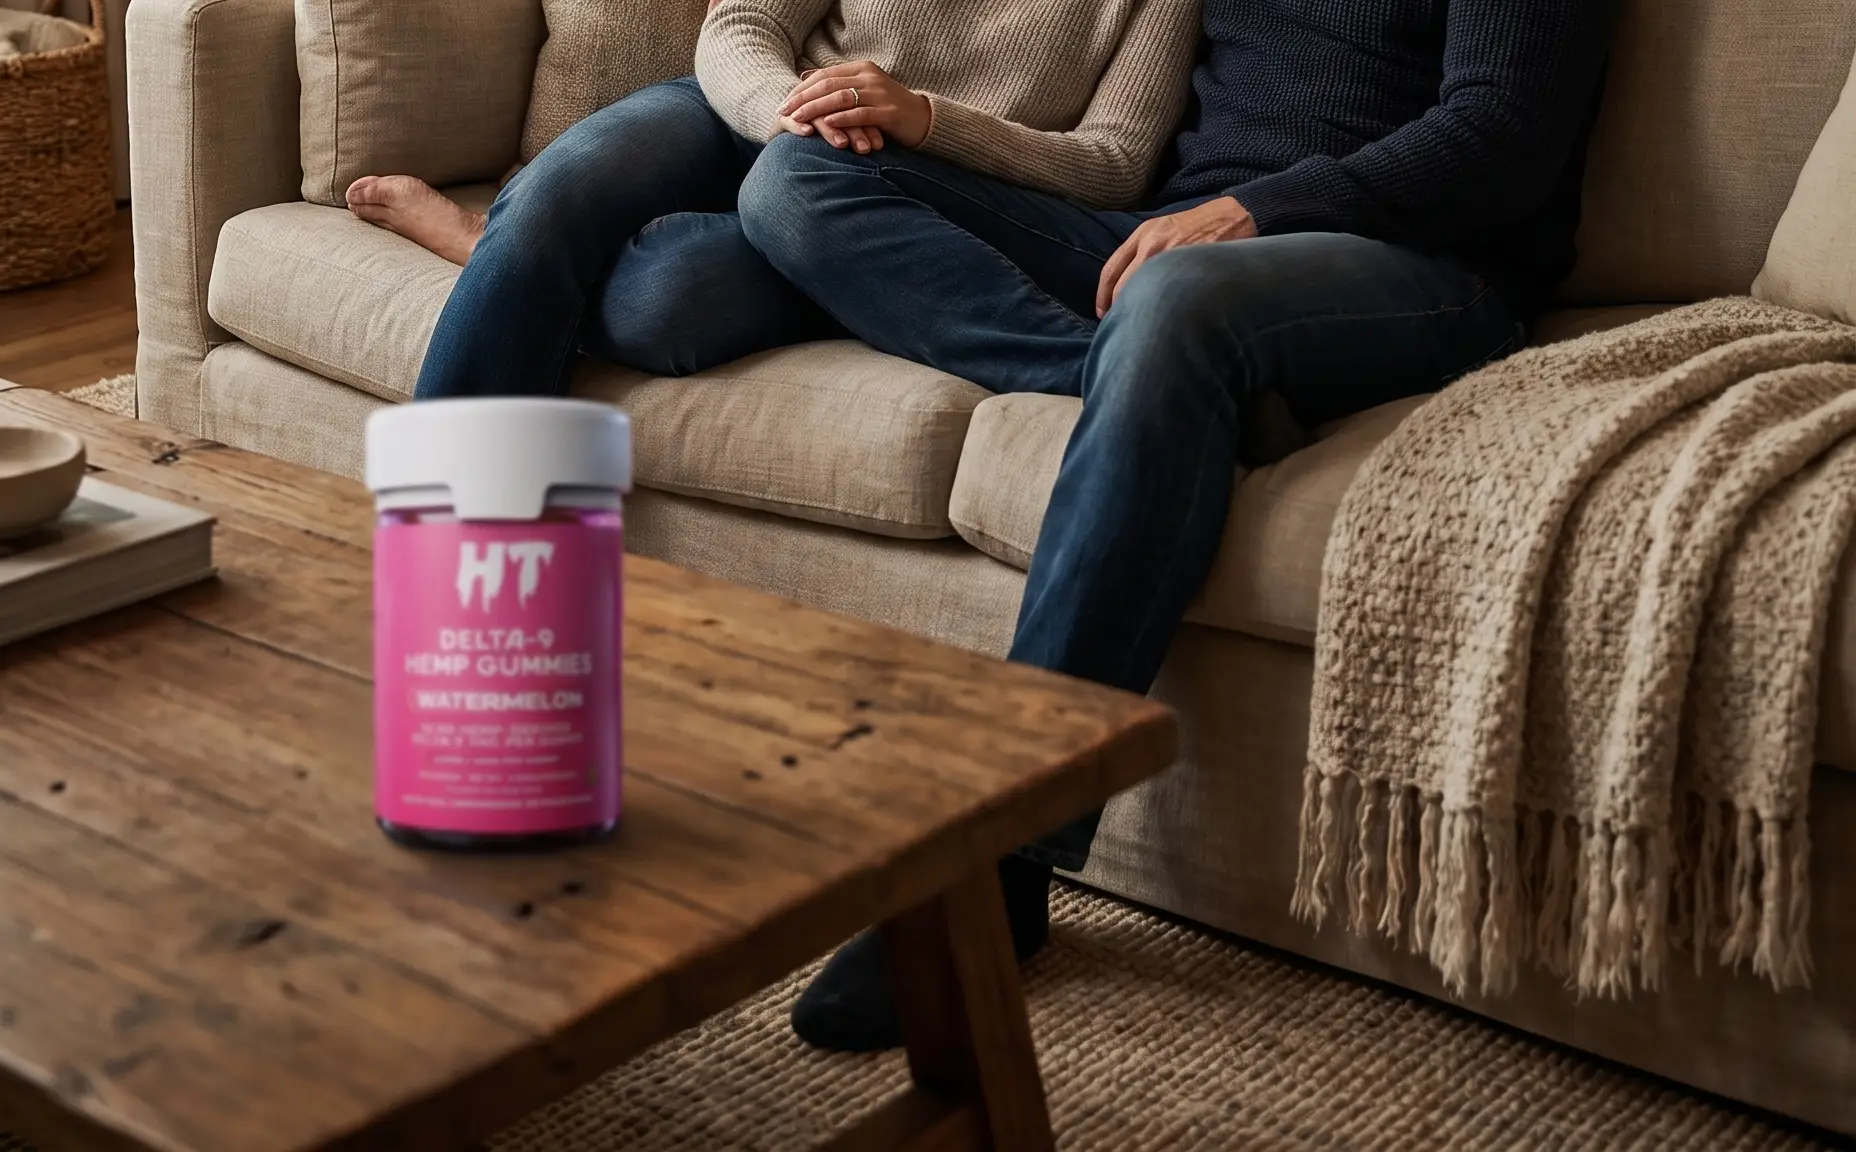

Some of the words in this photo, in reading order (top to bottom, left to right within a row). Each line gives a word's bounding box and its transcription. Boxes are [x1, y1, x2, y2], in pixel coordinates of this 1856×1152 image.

[457, 541, 554, 614] HT
[439, 629, 555, 650] DELTA-9
[405, 653, 469, 675] HEMP
[476, 653, 593, 677] GUMMIES
[416, 690, 583, 710] WATERMELON
